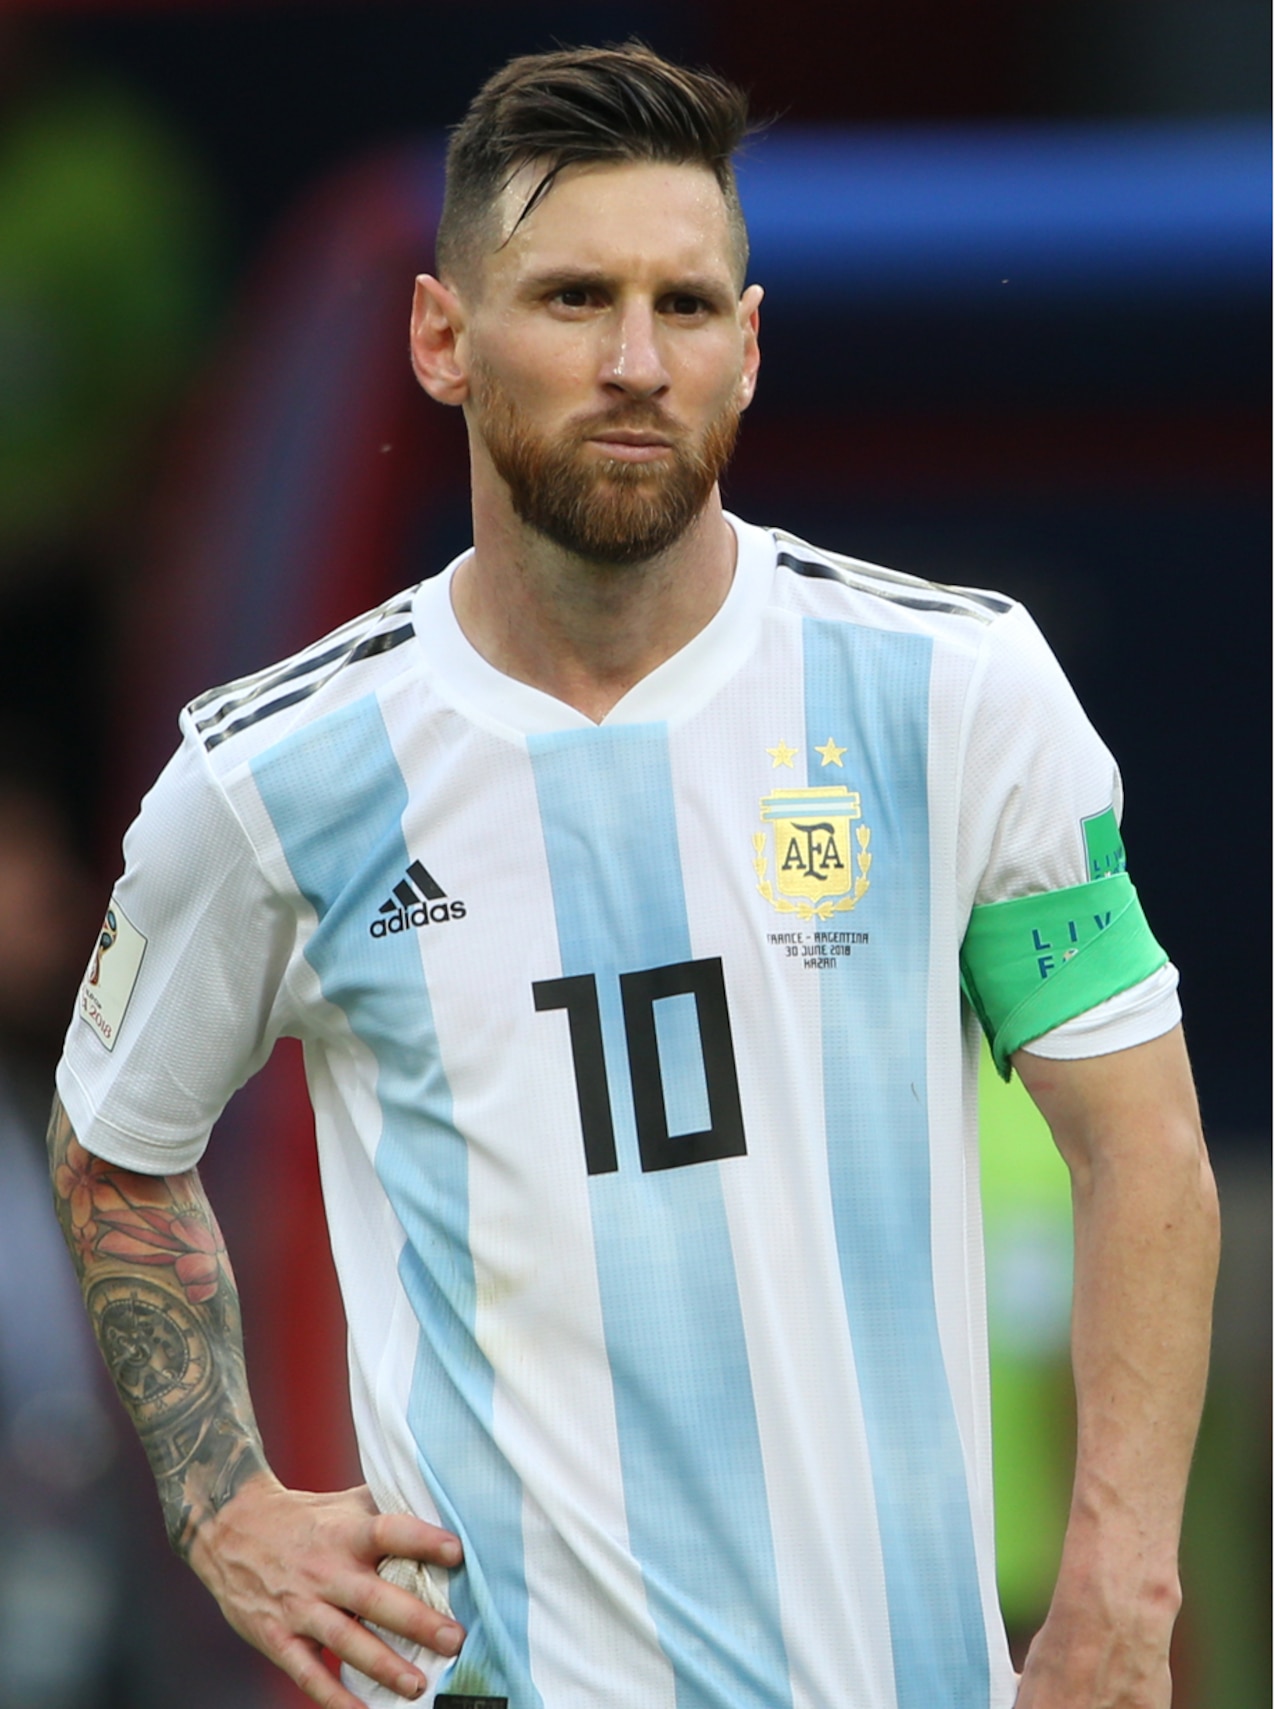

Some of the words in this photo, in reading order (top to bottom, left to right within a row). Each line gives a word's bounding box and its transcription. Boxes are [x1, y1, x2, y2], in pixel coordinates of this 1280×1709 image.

[781, 822, 845, 881] AFA
[369, 900, 467, 938] adidas
[785, 945, 798, 957] 30
[801, 945, 828, 957] JUNE
[830, 945, 851, 957] 2018
[814, 931, 869, 945] ARGENTINA
[803, 956, 838, 969] KAZAN
[89, 1004, 112, 1039] 2018
[531, 956, 748, 1176] 10
